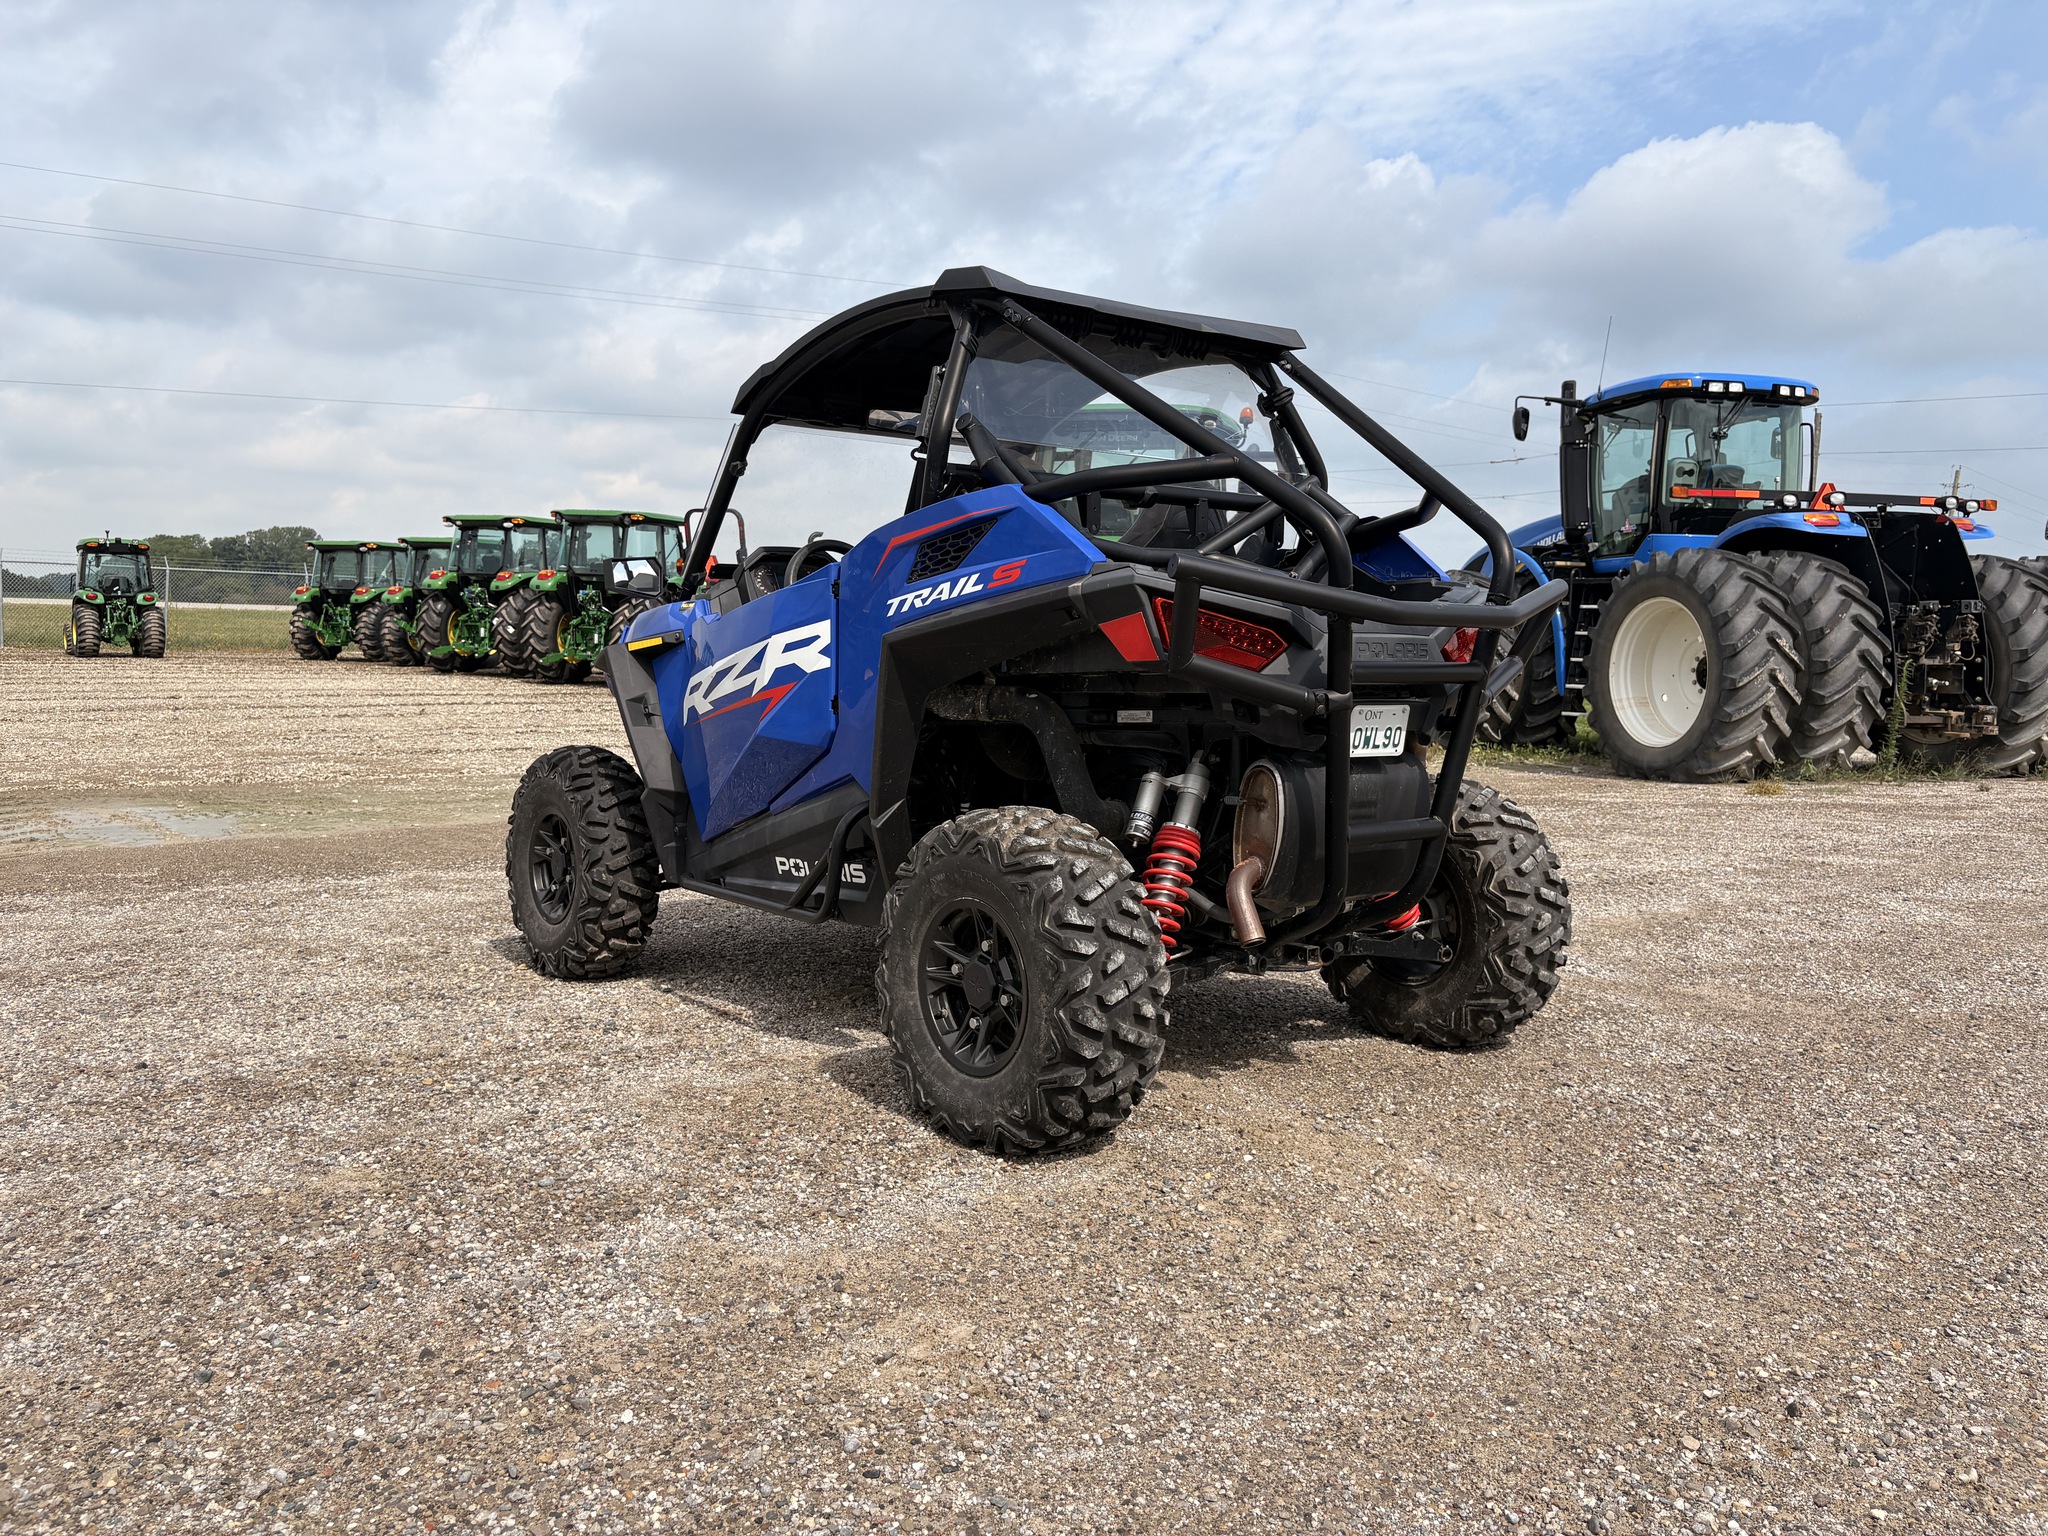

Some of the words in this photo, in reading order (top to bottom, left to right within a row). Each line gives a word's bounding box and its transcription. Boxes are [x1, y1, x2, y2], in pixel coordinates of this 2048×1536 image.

[886, 572, 984, 617] TRAIL
[987, 558, 1028, 589] S
[683, 618, 831, 727] RZR
[1355, 642, 1429, 660] POLARIS
[775, 856, 867, 884] POLIS
